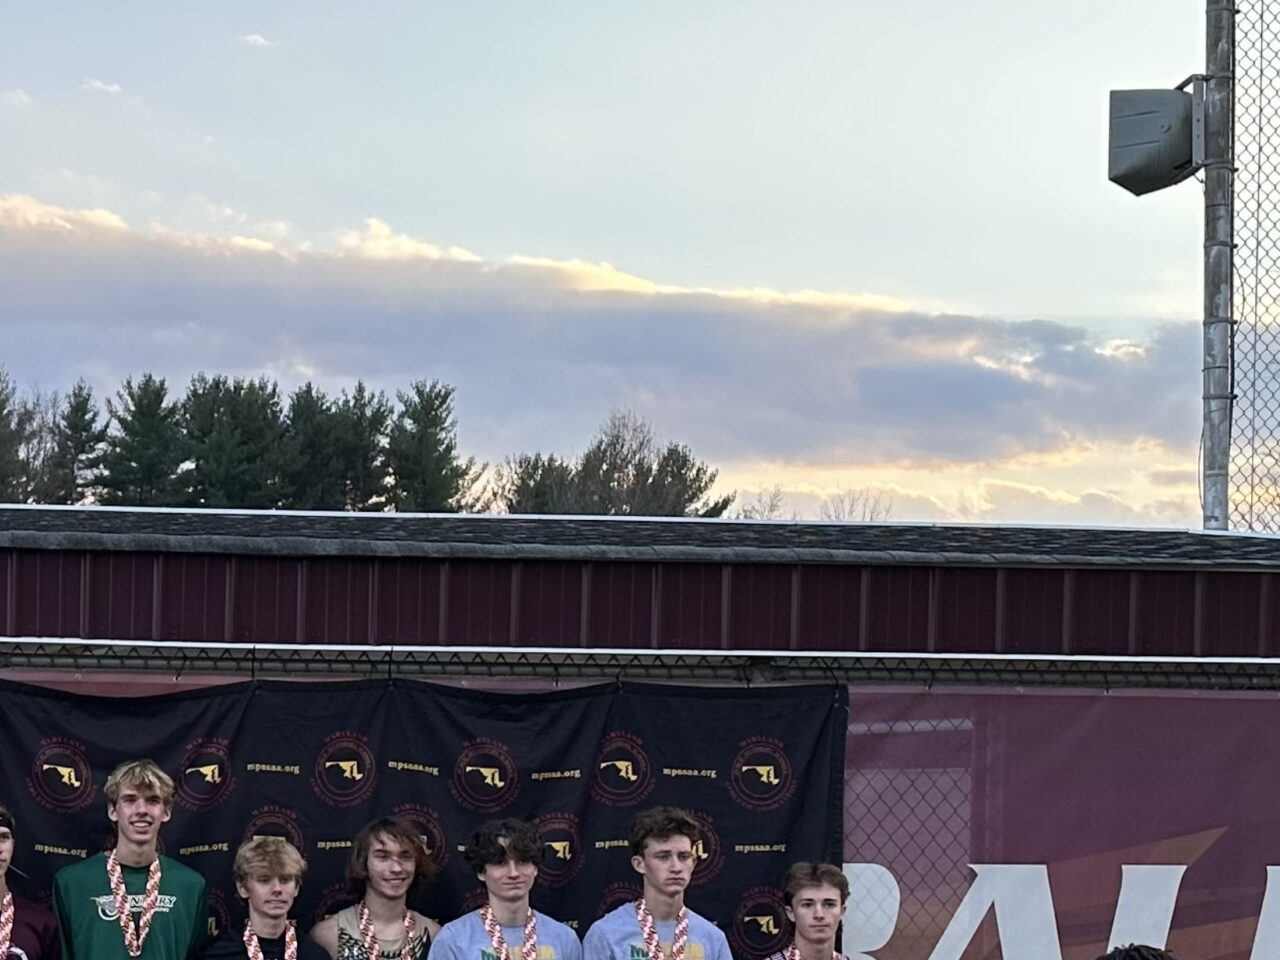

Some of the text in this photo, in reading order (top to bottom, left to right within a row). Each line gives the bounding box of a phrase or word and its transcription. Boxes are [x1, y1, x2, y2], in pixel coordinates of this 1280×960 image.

[247, 764, 299, 774] mpssaa.org
[389, 761, 438, 775] mpssaa.org
[662, 767, 717, 778] mpssaa.org
[532, 770, 581, 780] mpssaa.org
[34, 844, 88, 858] mpssaa.org
[178, 843, 230, 855] mpssaa.org
[733, 843, 787, 855] mpssaa.org
